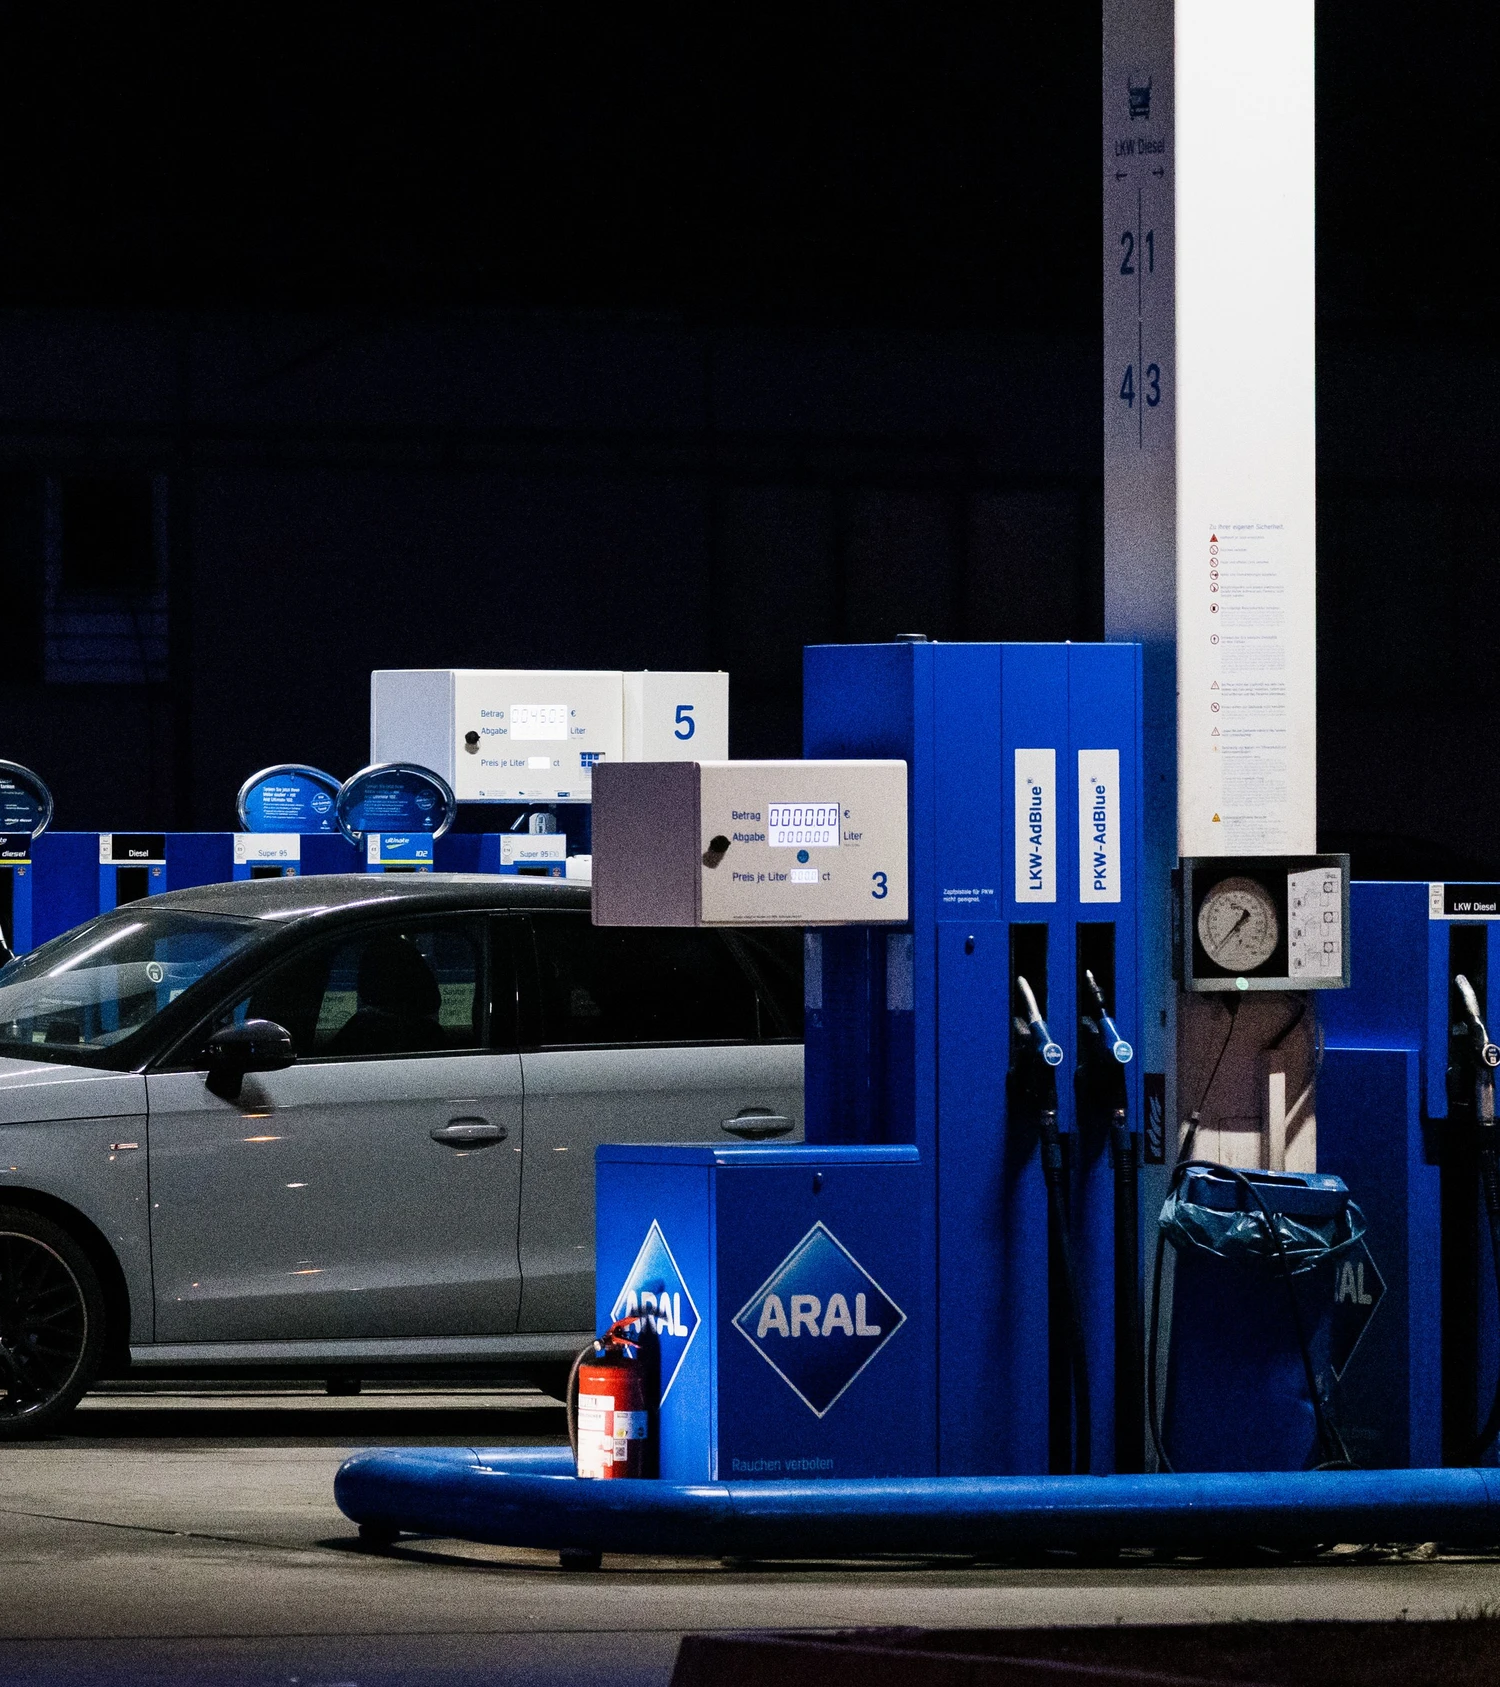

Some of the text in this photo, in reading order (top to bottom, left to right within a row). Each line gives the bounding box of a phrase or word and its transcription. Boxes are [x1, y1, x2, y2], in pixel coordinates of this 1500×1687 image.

[1115, 137, 1165, 158] LKW Diesel
[1120, 229, 1154, 275] 2 1
[1120, 363, 1161, 408] 4 3
[481, 709, 505, 719] Betrag
[571, 709, 576, 718] €
[674, 705, 695, 741] 5
[481, 727, 508, 737] Abgabe
[570, 727, 586, 735] Liter
[481, 759, 526, 770] Preis je Liter
[732, 810, 761, 822] Betrag
[844, 810, 851, 819] €
[384, 836, 410, 845] ultimate
[732, 832, 765, 843] Abgabe
[844, 831, 863, 841] Liter
[2, 850, 26, 858] diesel
[129, 849, 149, 857] Diesel
[258, 849, 288, 858] Super 95
[520, 850, 539, 858] Super
[732, 872, 788, 884] Preis je Liter
[822, 872, 830, 881] ct
[871, 871, 888, 899] 3
[1453, 902, 1497, 911] LKW Diesel
[756, 1293, 882, 1338] ARAL
[732, 1456, 834, 1473] Rauchen verboten
